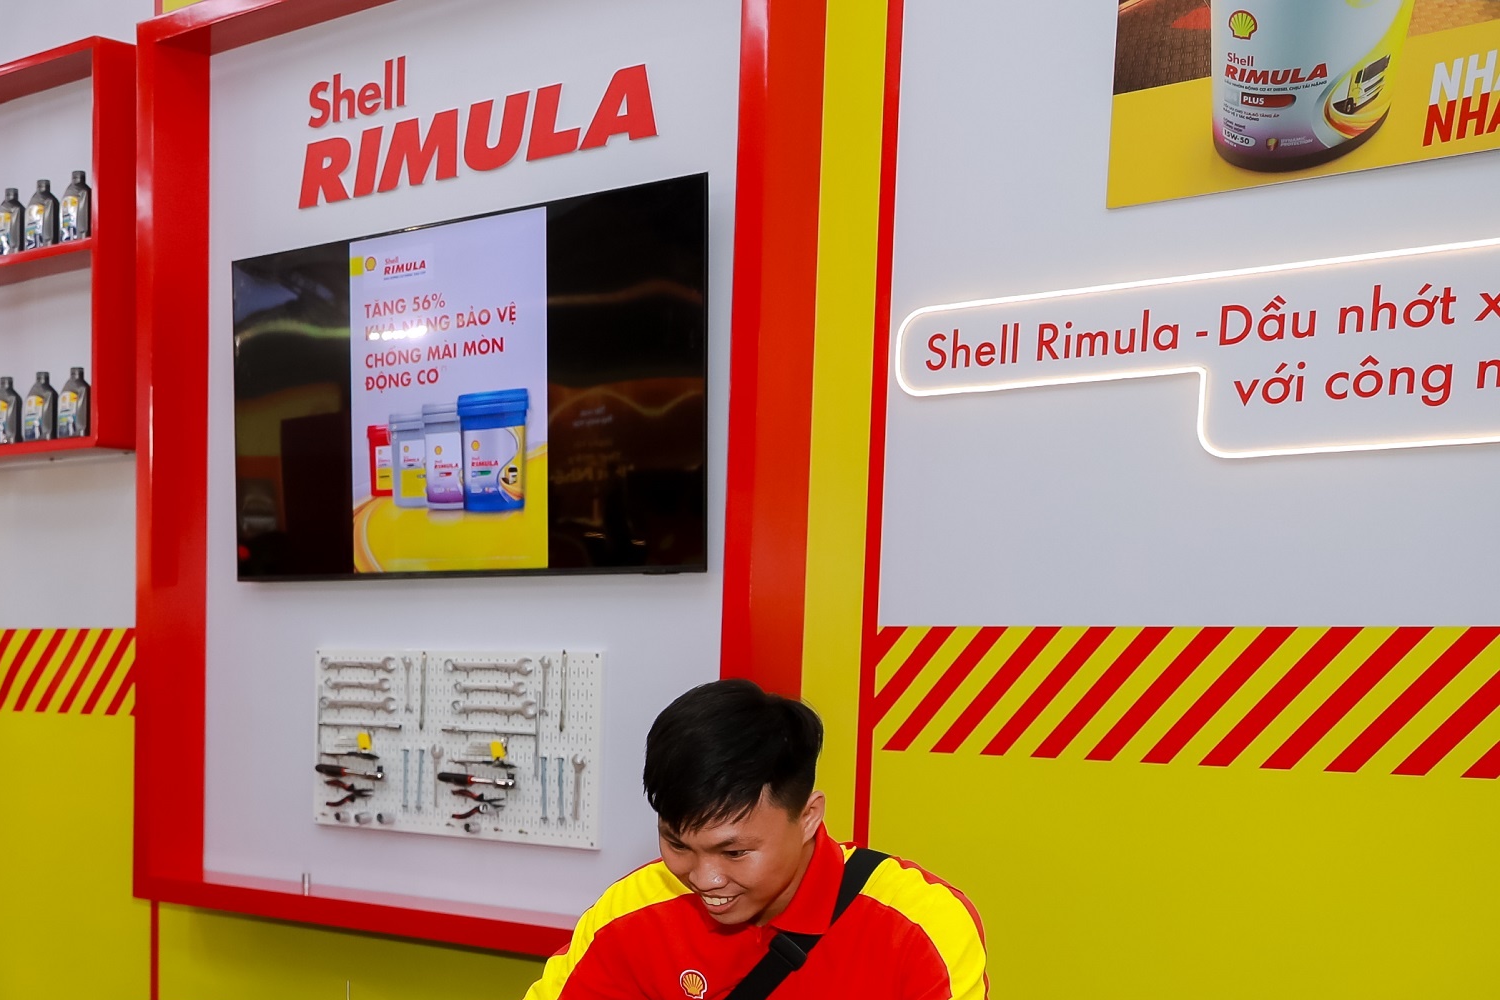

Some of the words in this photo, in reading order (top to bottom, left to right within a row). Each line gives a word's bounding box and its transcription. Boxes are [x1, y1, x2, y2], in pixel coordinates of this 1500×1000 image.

[1228, 52, 1254, 66] Shell
[1225, 63, 1327, 85] RIMULA
[1429, 50, 1500, 106] NH
[308, 55, 406, 128] Shell
[1243, 96, 1265, 105] PLUS
[298, 64, 658, 209] RIMULA
[1224, 129, 1250, 144] 15W-50
[384, 260, 426, 275] RIMULA
[364, 299, 406, 319] TĂNG
[412, 293, 445, 312] 56%
[457, 305, 491, 328] BẢO
[497, 301, 516, 325] VỆ
[925, 323, 1019, 371] Shell
[1037, 309, 1179, 361] Rimula
[1338, 283, 1456, 334] nhớt
[365, 345, 421, 368] CHỐNG
[427, 340, 457, 361] MÀI
[463, 334, 504, 357] MÒN
[365, 371, 411, 393] ĐỘNG
[418, 367, 439, 385] CƠ
[1234, 361, 1306, 406] với
[1325, 355, 1453, 406] công
